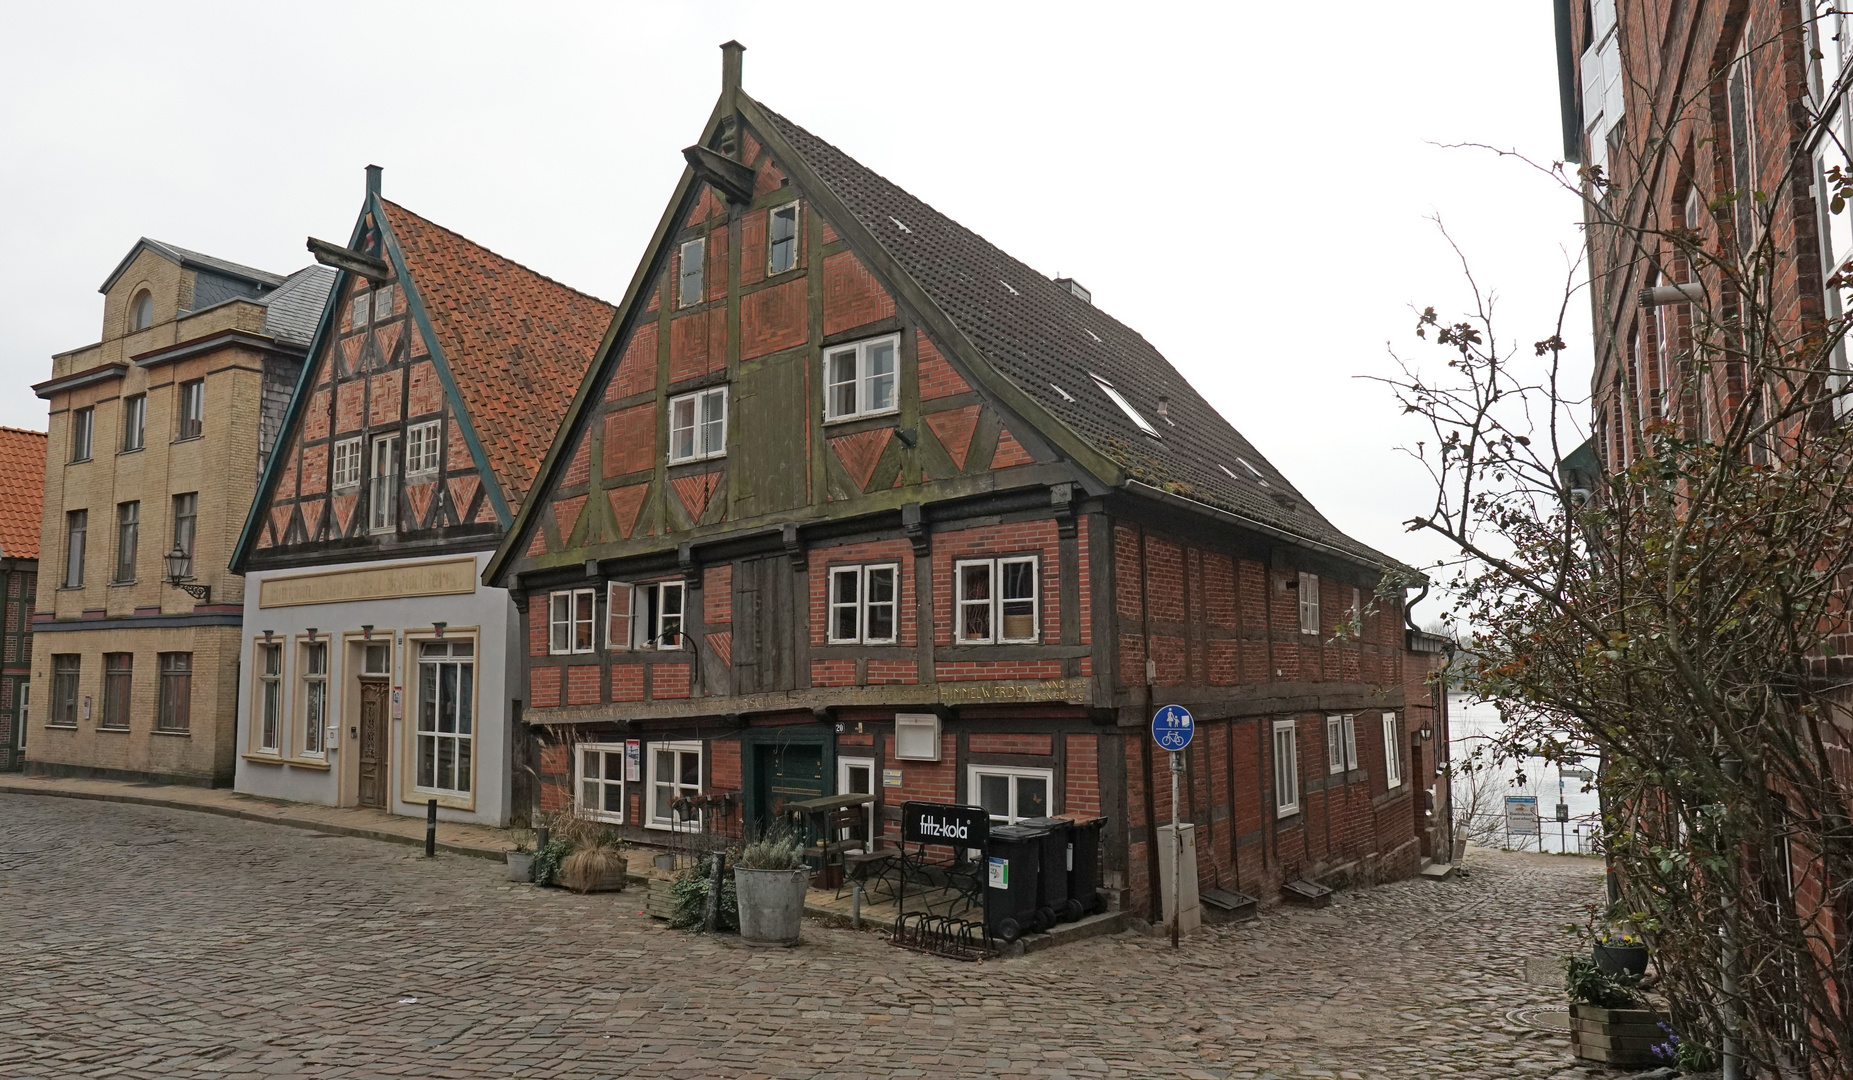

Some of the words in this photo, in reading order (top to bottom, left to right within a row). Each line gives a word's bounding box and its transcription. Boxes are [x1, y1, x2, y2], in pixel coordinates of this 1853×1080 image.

[1038, 679, 1065, 689] ANNO
[941, 686, 981, 700] HIMMEL
[981, 685, 1032, 699] WERDEN
[835, 723, 844, 732] 20
[920, 814, 968, 840] fritz-kola
